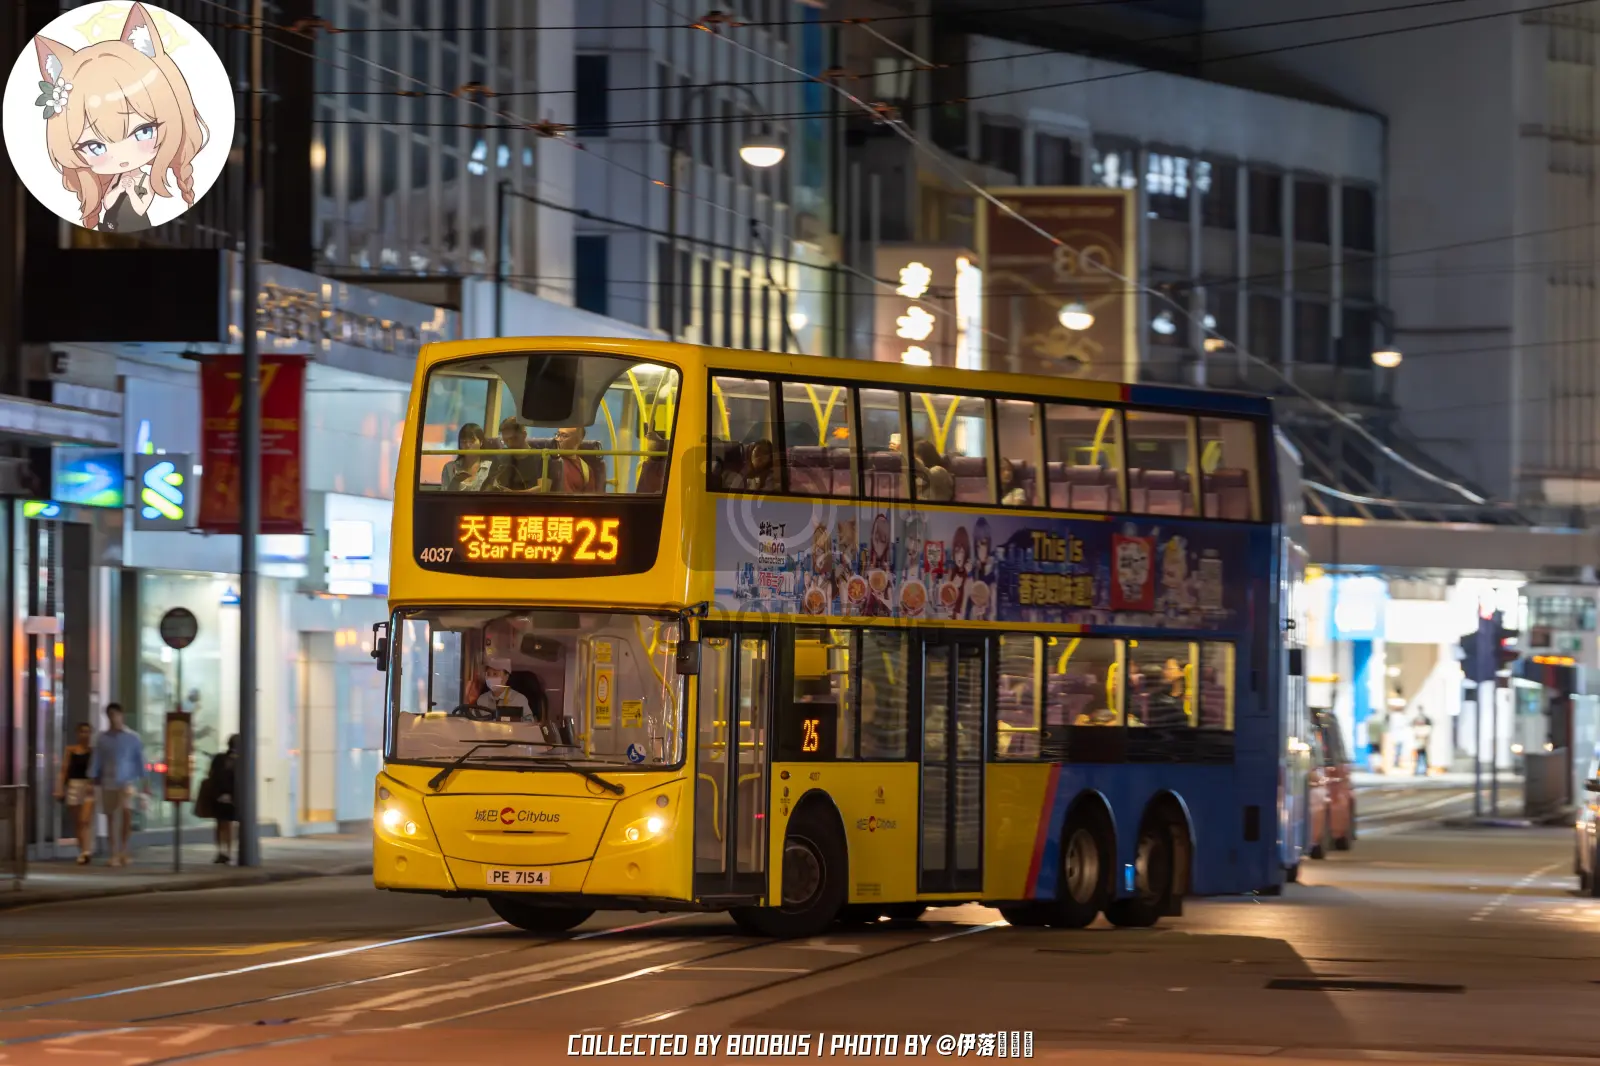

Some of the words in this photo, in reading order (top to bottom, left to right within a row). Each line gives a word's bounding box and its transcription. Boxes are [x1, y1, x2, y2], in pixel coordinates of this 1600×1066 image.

[460, 515, 575, 544] 天星碼頭
[759, 521, 786, 537] 出前一丁
[574, 520, 620, 561] 25
[1031, 530, 1067, 562] This
[1069, 533, 1084, 562] is
[419, 547, 454, 564] 4037
[468, 541, 509, 559] Star
[512, 541, 563, 562] Ferry
[802, 719, 820, 752] 25
[474, 808, 499, 823] 城巴
[517, 809, 561, 824] Citybus
[493, 870, 510, 883] PE
[515, 871, 545, 885] 7154
